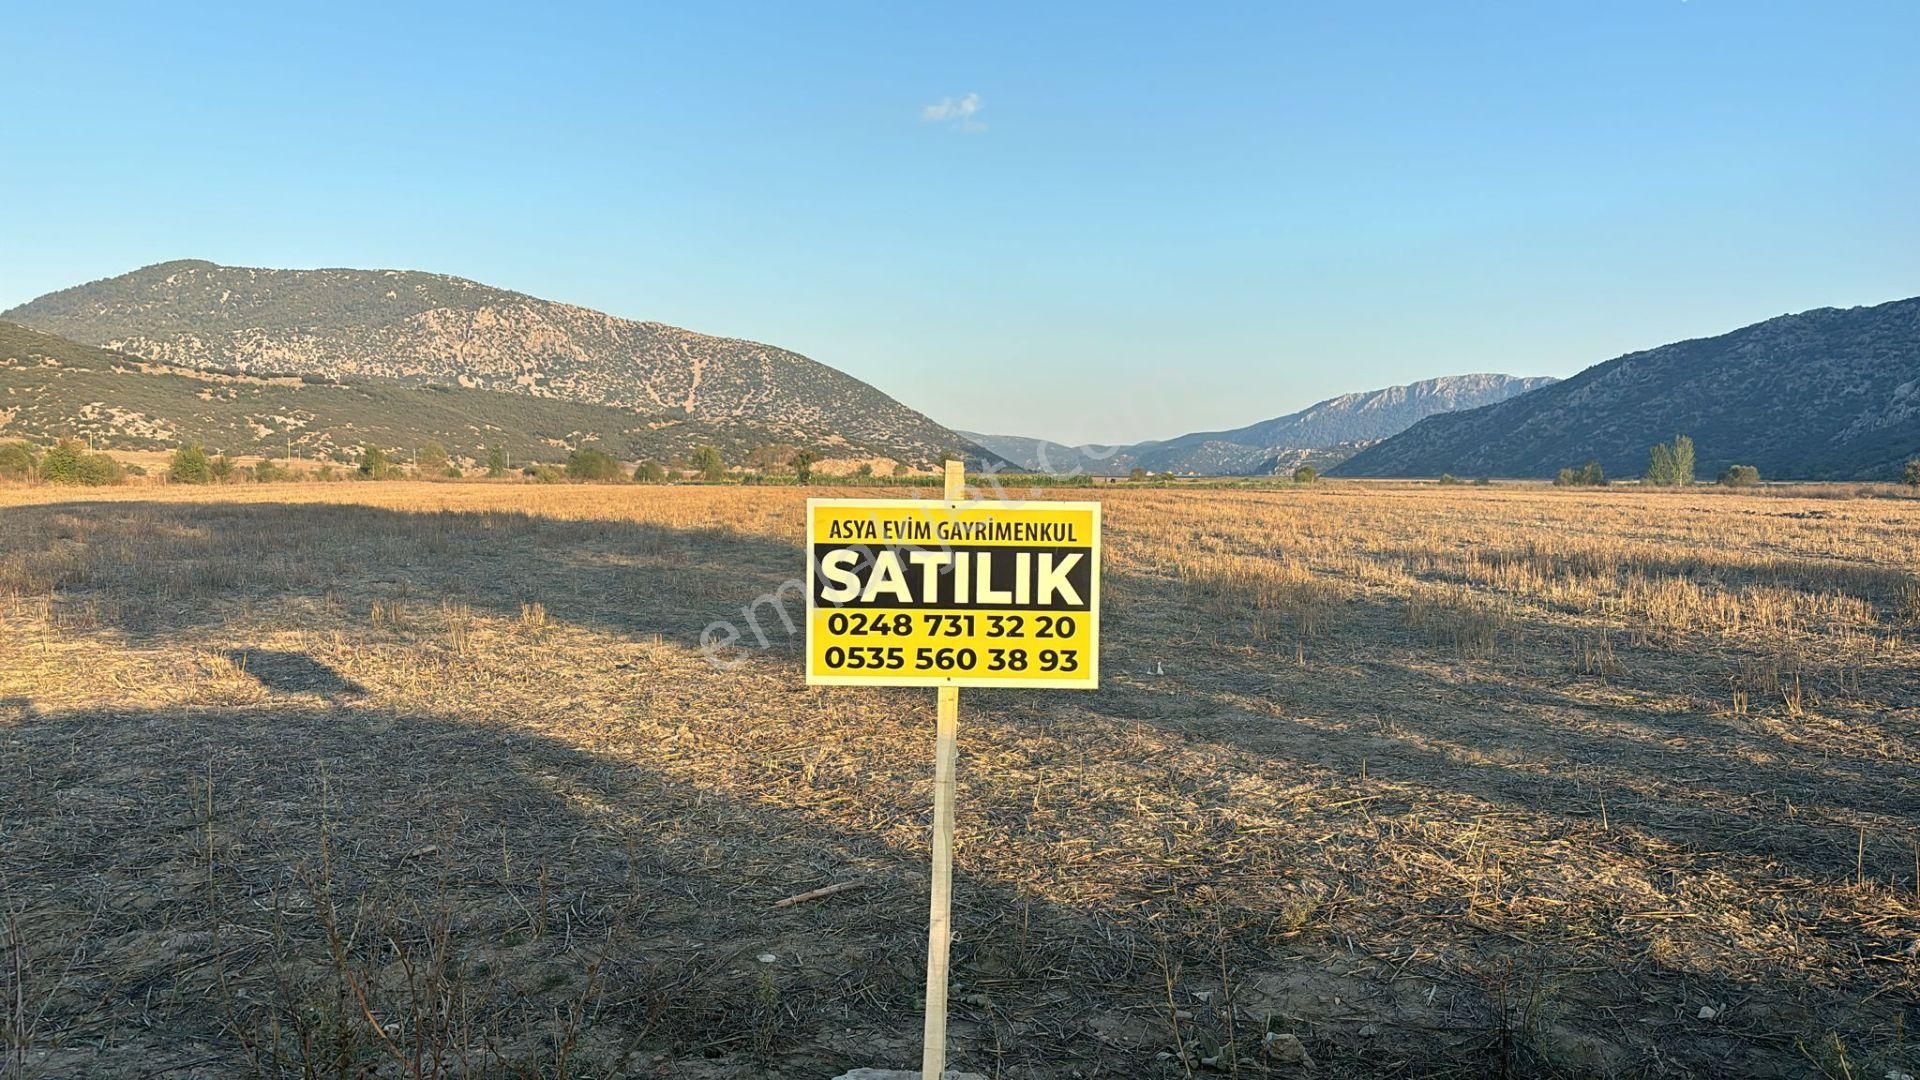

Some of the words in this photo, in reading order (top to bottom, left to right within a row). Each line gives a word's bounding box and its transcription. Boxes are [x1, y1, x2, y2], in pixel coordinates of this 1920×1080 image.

[829, 519, 877, 539] ASYA
[883, 516, 931, 540] EVİM
[937, 517, 1077, 542] GAYRİMENKUL
[820, 549, 1084, 605] SATILIK
[828, 613, 913, 637] 0248
[924, 614, 975, 637] 731
[986, 615, 1025, 638] 32
[1035, 615, 1076, 639] 20
[824, 646, 905, 670] 0535
[915, 647, 977, 671] 560
[987, 648, 1028, 672] 38
[1039, 649, 1078, 673] 93
